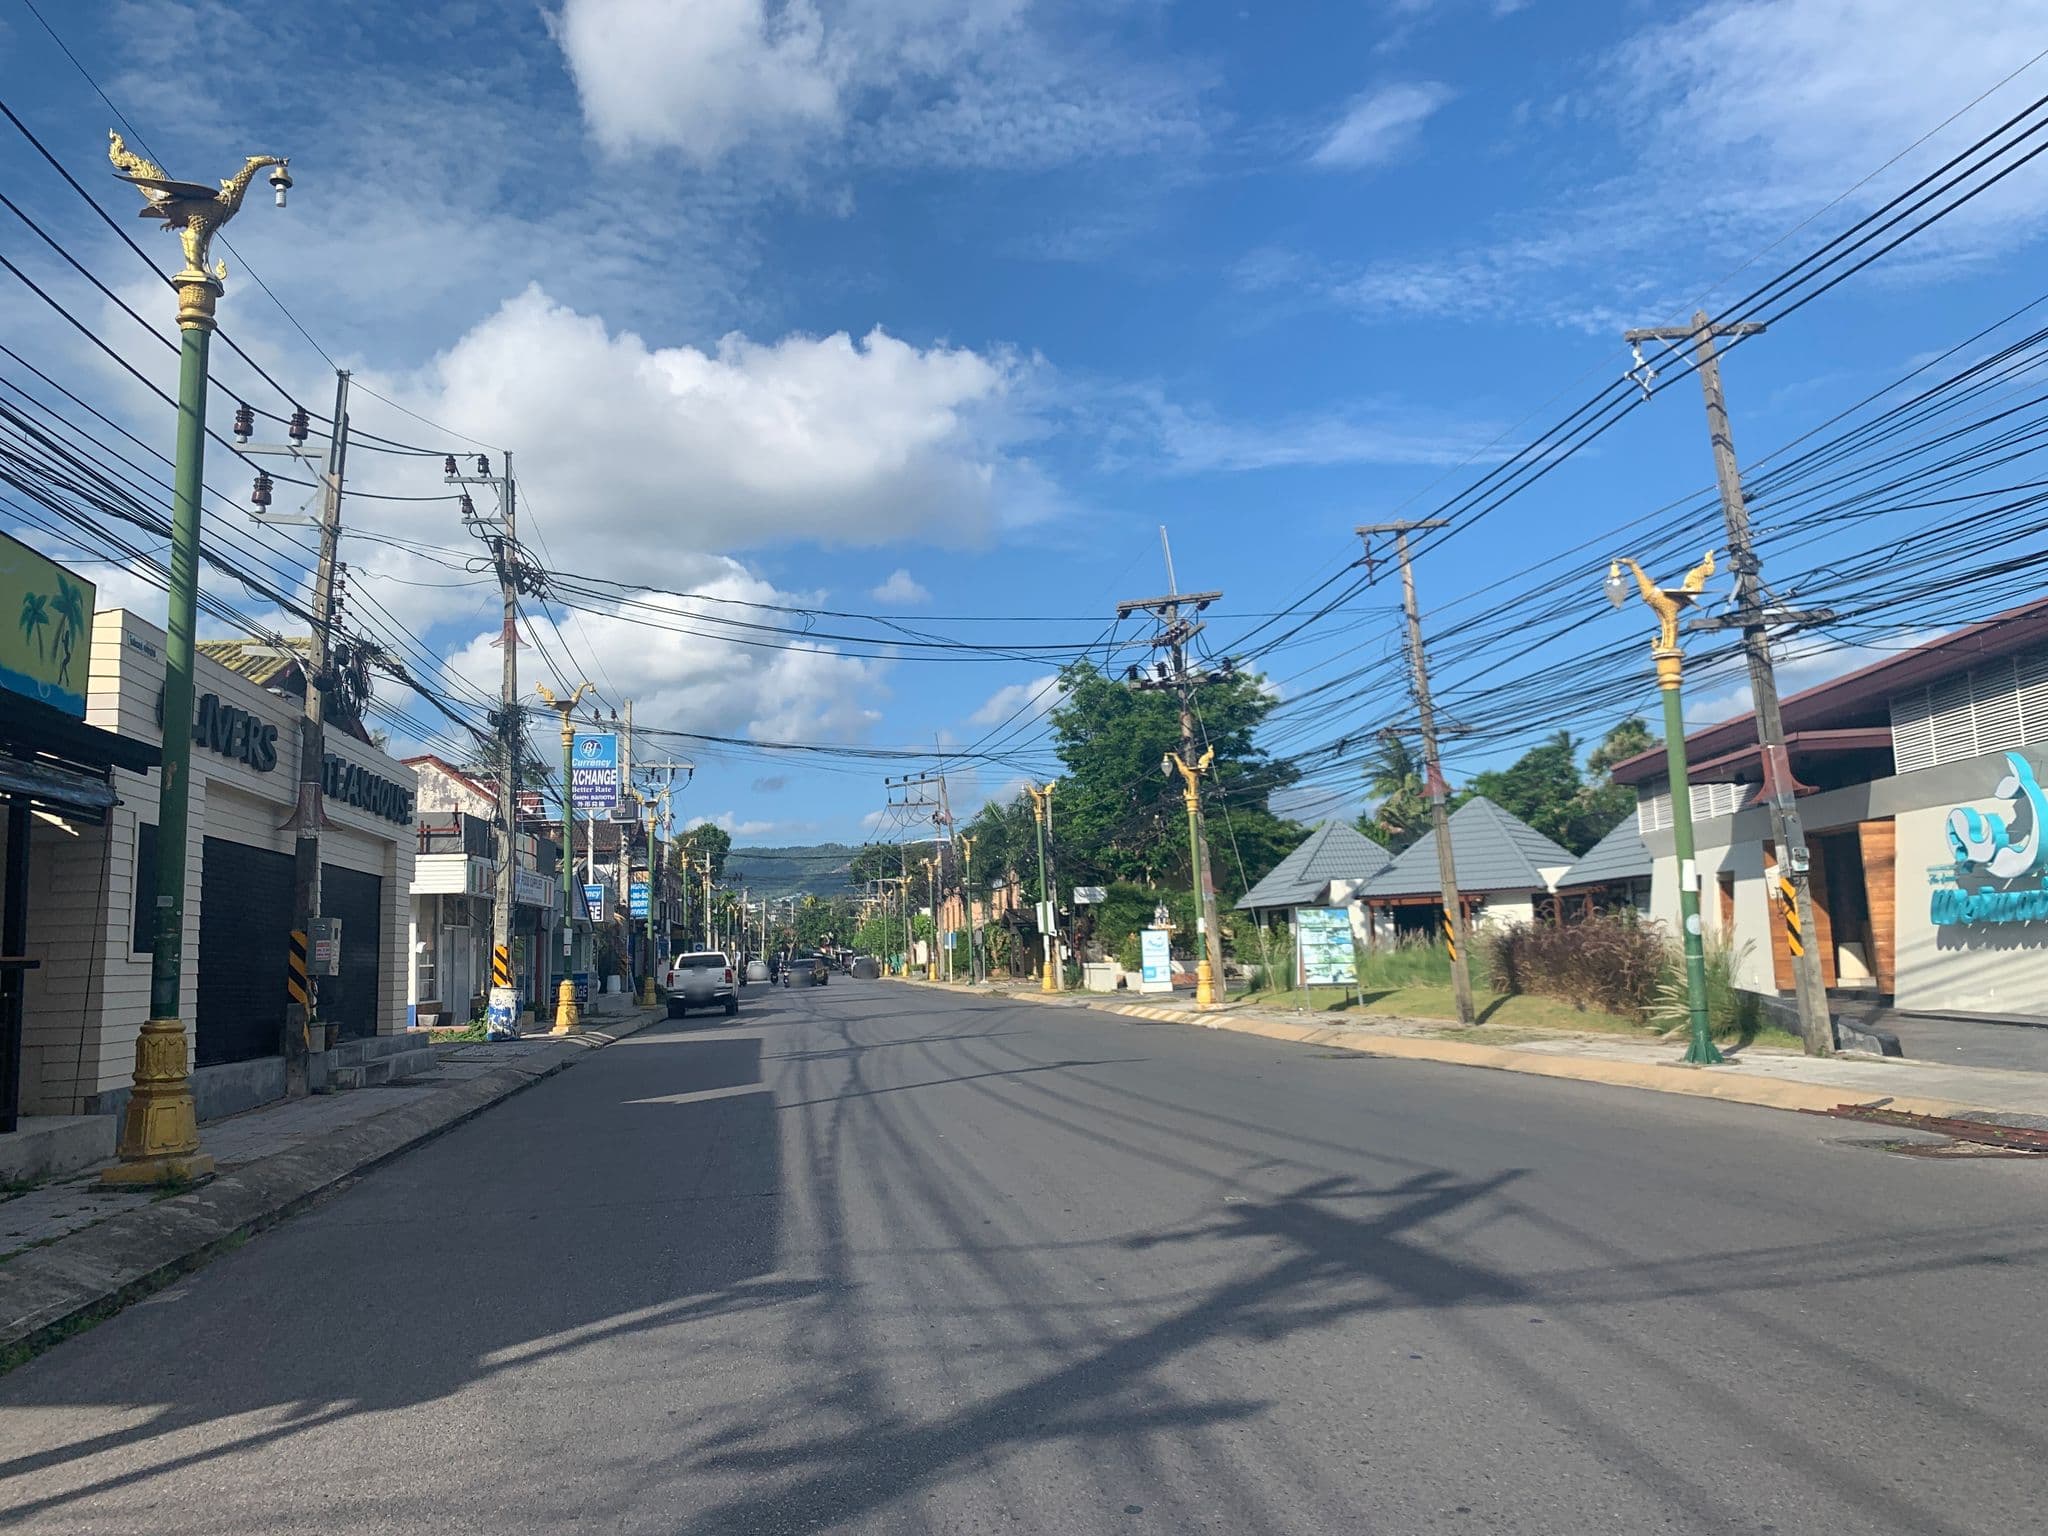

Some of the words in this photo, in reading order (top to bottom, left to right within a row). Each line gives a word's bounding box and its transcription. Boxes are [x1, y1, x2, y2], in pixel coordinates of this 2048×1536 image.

[156, 681, 278, 772] LIVERS
[582, 741, 599, 758] BJ
[572, 759, 612, 768] Currency
[572, 769, 617, 785] XCHANGE
[320, 753, 415, 826] TEAKHOUSE
